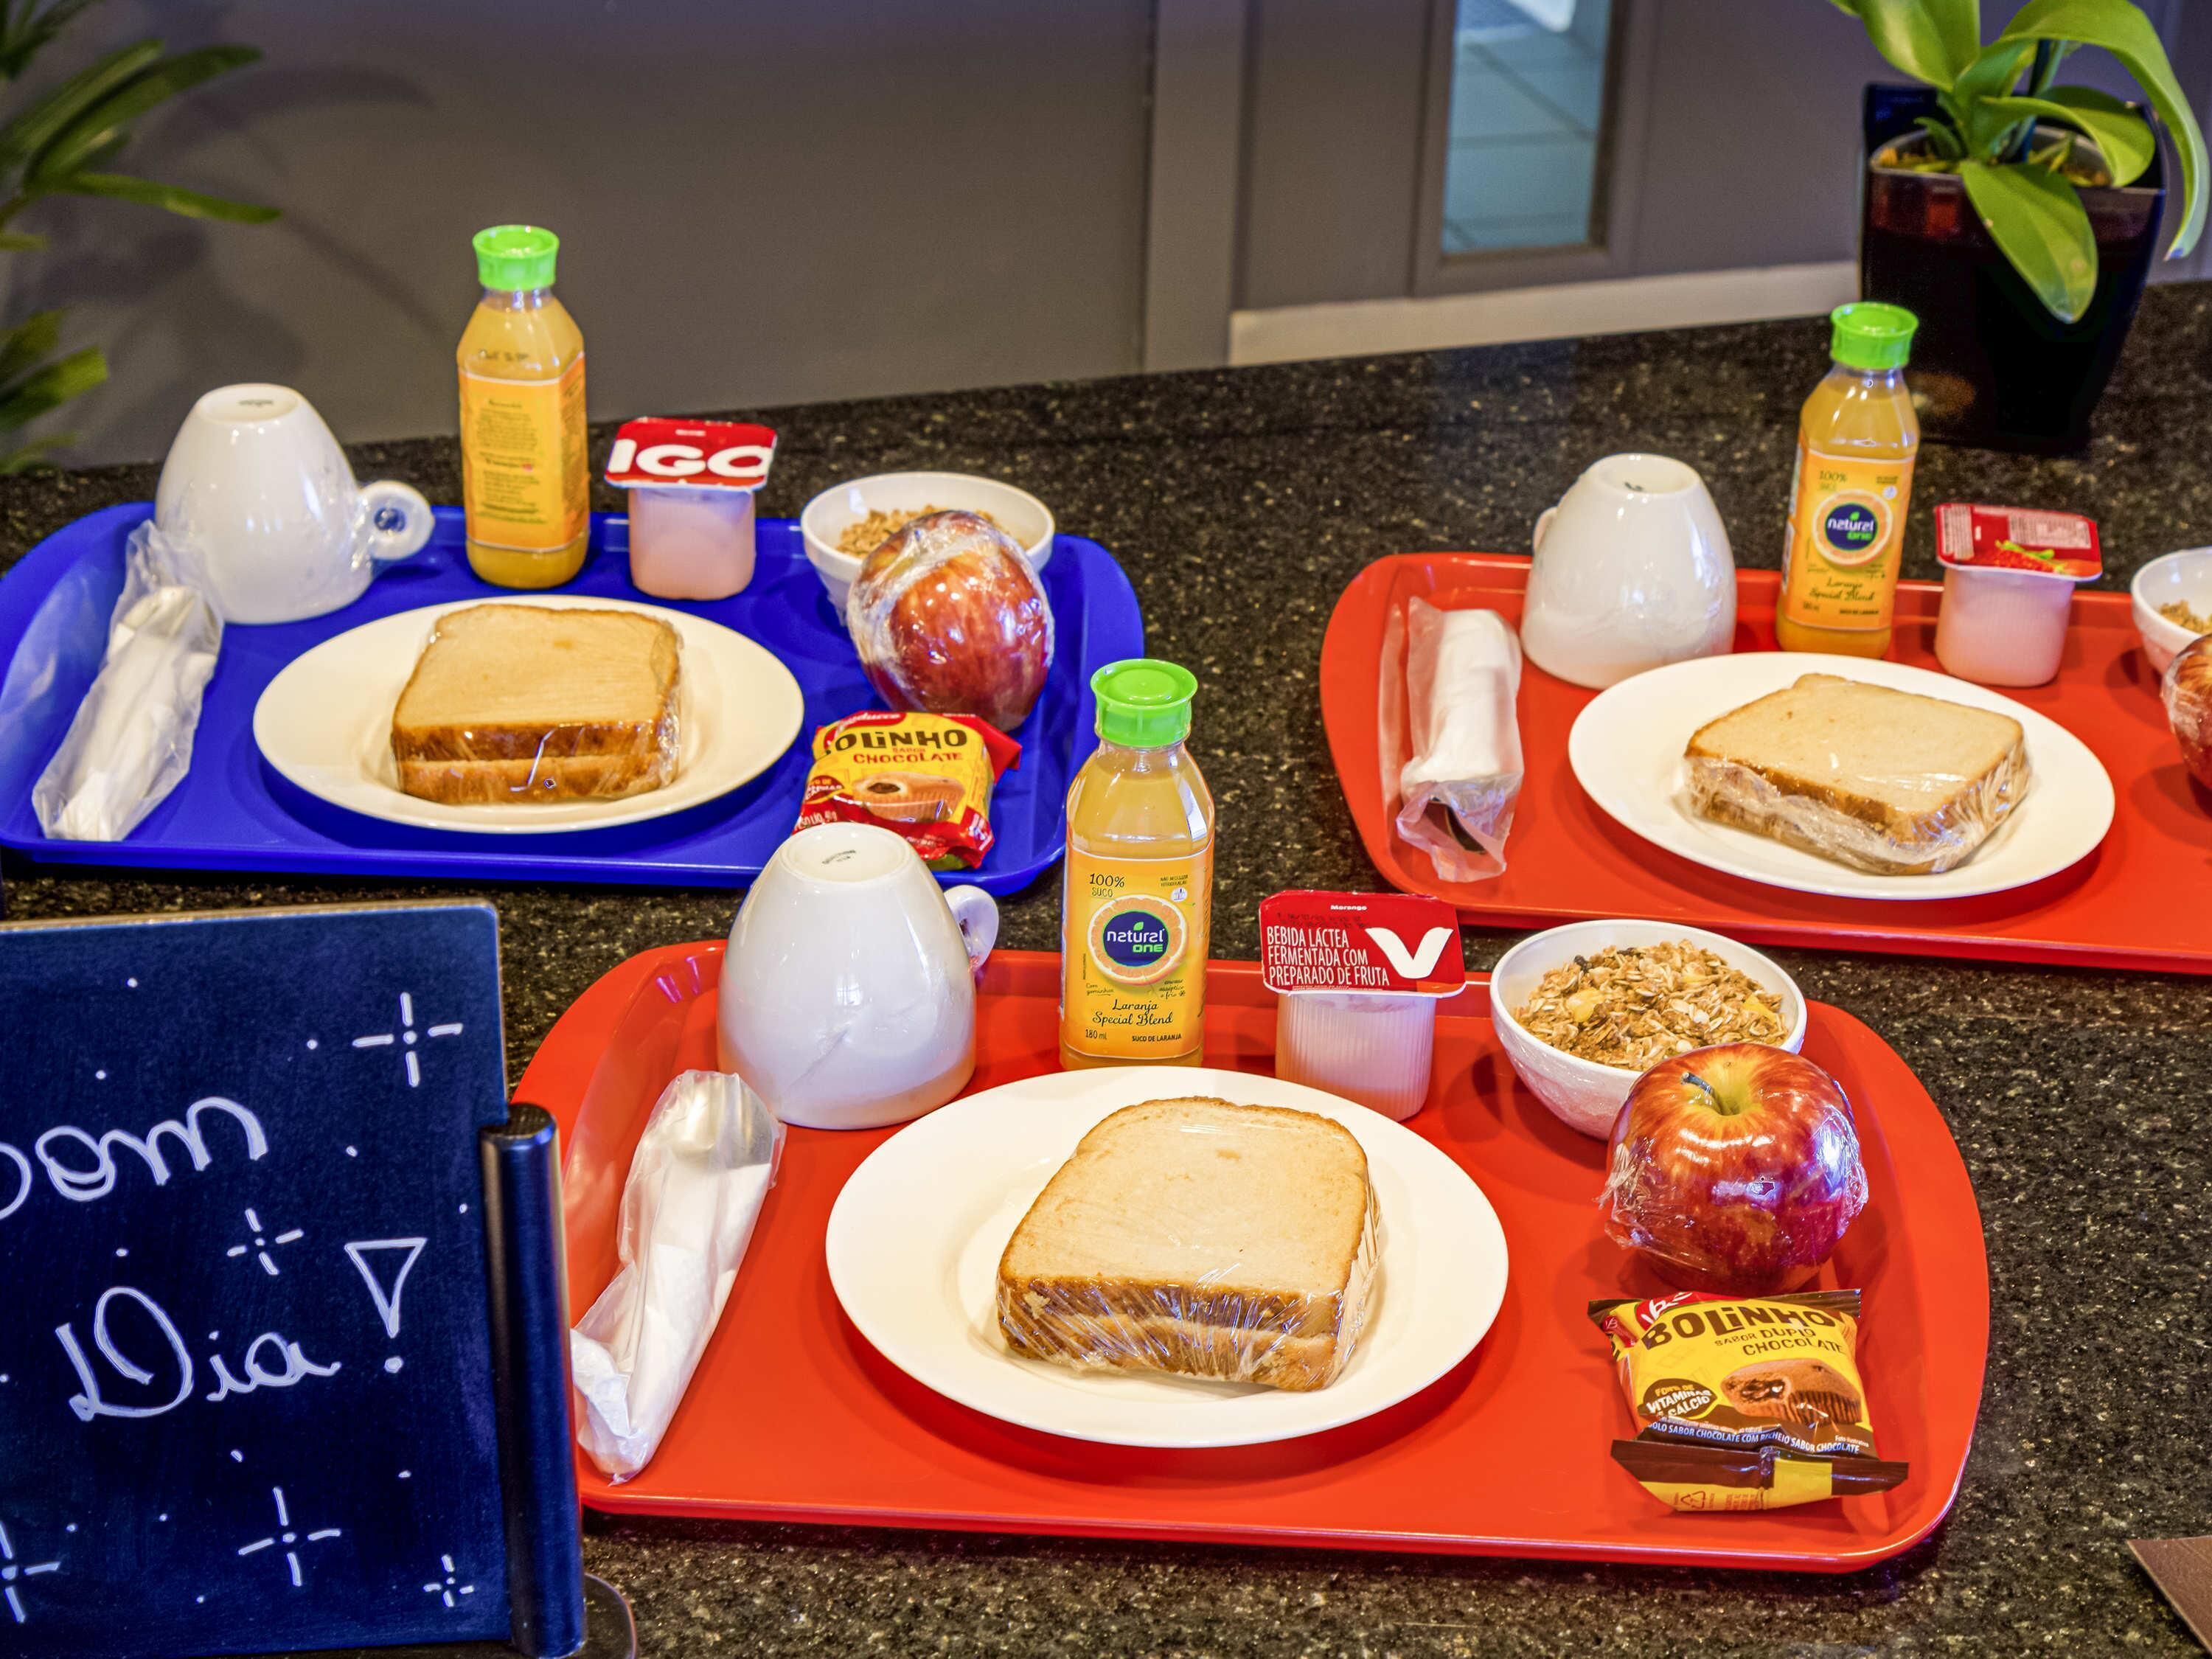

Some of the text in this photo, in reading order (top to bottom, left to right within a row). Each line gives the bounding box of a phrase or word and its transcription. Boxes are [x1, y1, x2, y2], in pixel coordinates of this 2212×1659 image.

[1827, 518, 1874, 532] natural
[852, 751, 964, 765] CHOCOLATE
[1089, 873, 1126, 888] 100%
[1091, 887, 1114, 897] SUCO
[1107, 929, 1165, 944] natural
[1267, 925, 1350, 949] BEBIDA LÁCTEA
[1267, 945, 1368, 967] FERMENTADA COM
[1269, 965, 1391, 987] PREPARADO DE FRUTA
[1112, 999, 1159, 1015] Laranja
[1092, 1011, 1174, 1027] Special Blend
[1085, 1029, 1098, 1039] 180
[1157, 1033, 1182, 1041] LARANJA
[1714, 1332, 1758, 1347] SABOR
[1742, 1338, 1846, 1357] CHOCOLATE
[1646, 1389, 1713, 1415] VITAMINAS
[1668, 1425, 1695, 1437] SABOR
[1695, 1428, 1741, 1443] CHOCOLATE
[1742, 1434, 1759, 1444] COM
[1790, 1437, 1816, 1453] SABOR
[1816, 1441, 1860, 1454] CHOCOLATE
